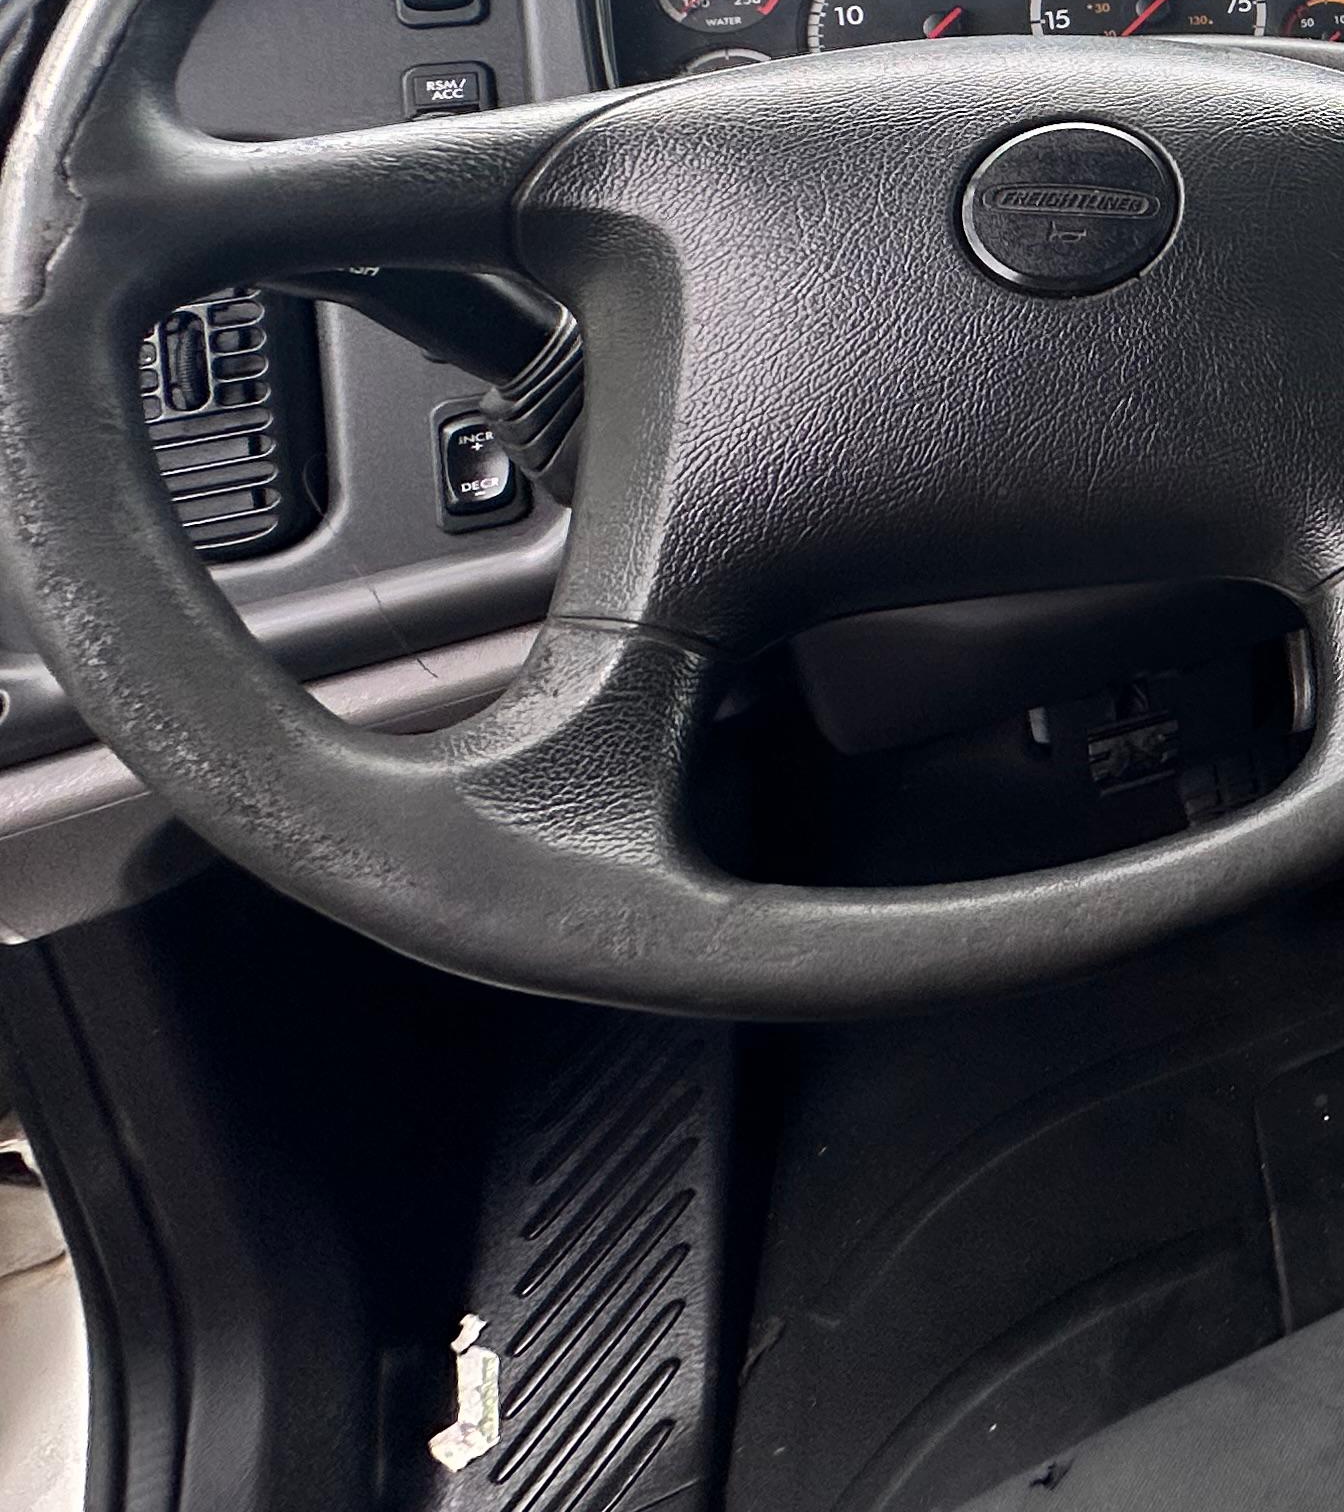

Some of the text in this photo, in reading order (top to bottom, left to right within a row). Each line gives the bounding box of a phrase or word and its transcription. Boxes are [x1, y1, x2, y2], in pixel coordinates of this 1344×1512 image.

[1094, 2, 1110, 13] 30
[705, 16, 742, 26] WATER
[834, 5, 864, 26] 10
[1045, 8, 1071, 30] 15
[1189, 15, 1207, 25] 130
[1300, 17, 1315, 28] 50
[431, 89, 465, 100] ACC
[1000, 190, 1142, 212] FREIGHTLINER
[458, 431, 494, 445] INCR
[461, 477, 499, 493] DECR
